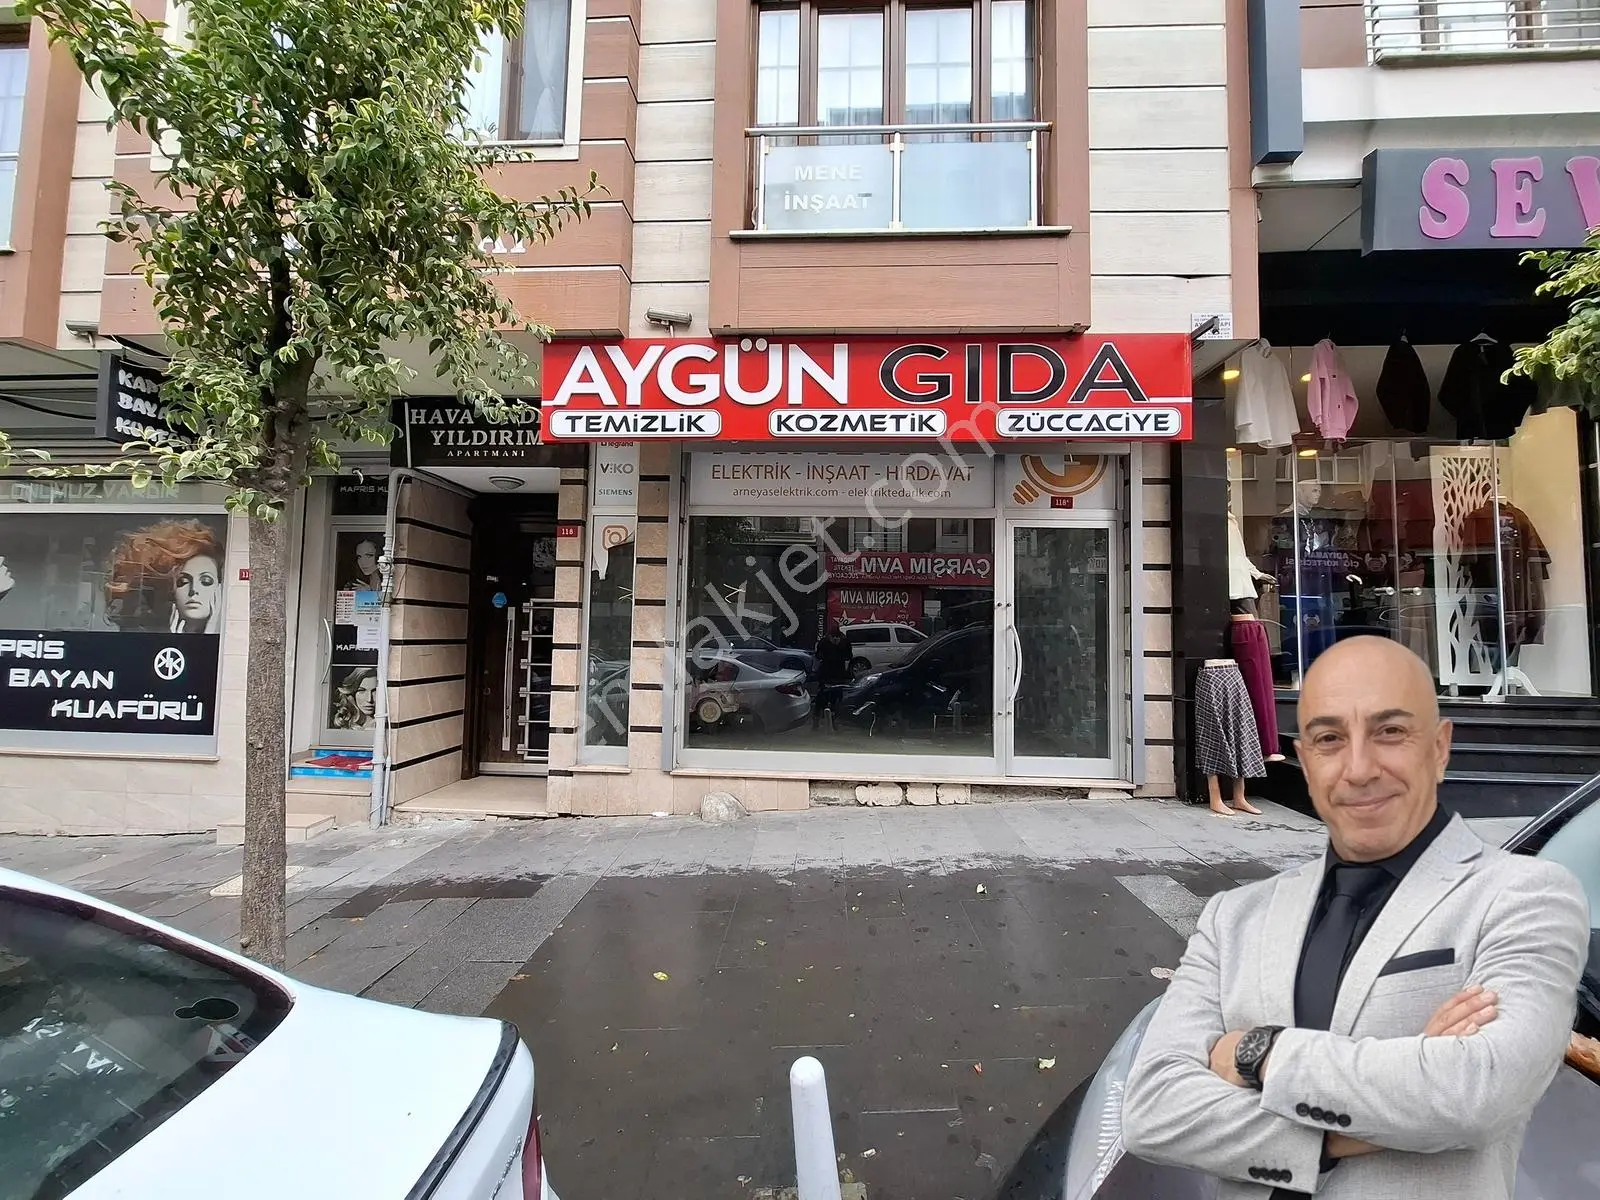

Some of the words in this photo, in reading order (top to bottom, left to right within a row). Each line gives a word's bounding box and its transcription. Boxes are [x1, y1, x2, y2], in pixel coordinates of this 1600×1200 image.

[794, 164, 863, 182] MENE
[784, 189, 872, 215] İNŞAAT
[1418, 155, 1600, 240] SEV
[552, 337, 849, 406] AYGÜN
[878, 341, 1150, 405] GIDA
[410, 408, 475, 424] HAVA
[431, 430, 544, 446] YILDIRIM
[711, 461, 791, 480] ELEKTRİK
[806, 462, 870, 484] İNŞAAT
[886, 464, 975, 482] HIRDAVAT
[732, 486, 838, 498] arneyaselektrik.com
[8, 668, 115, 690] BAYAN
[51, 693, 203, 721] KUAFÖRÜ
